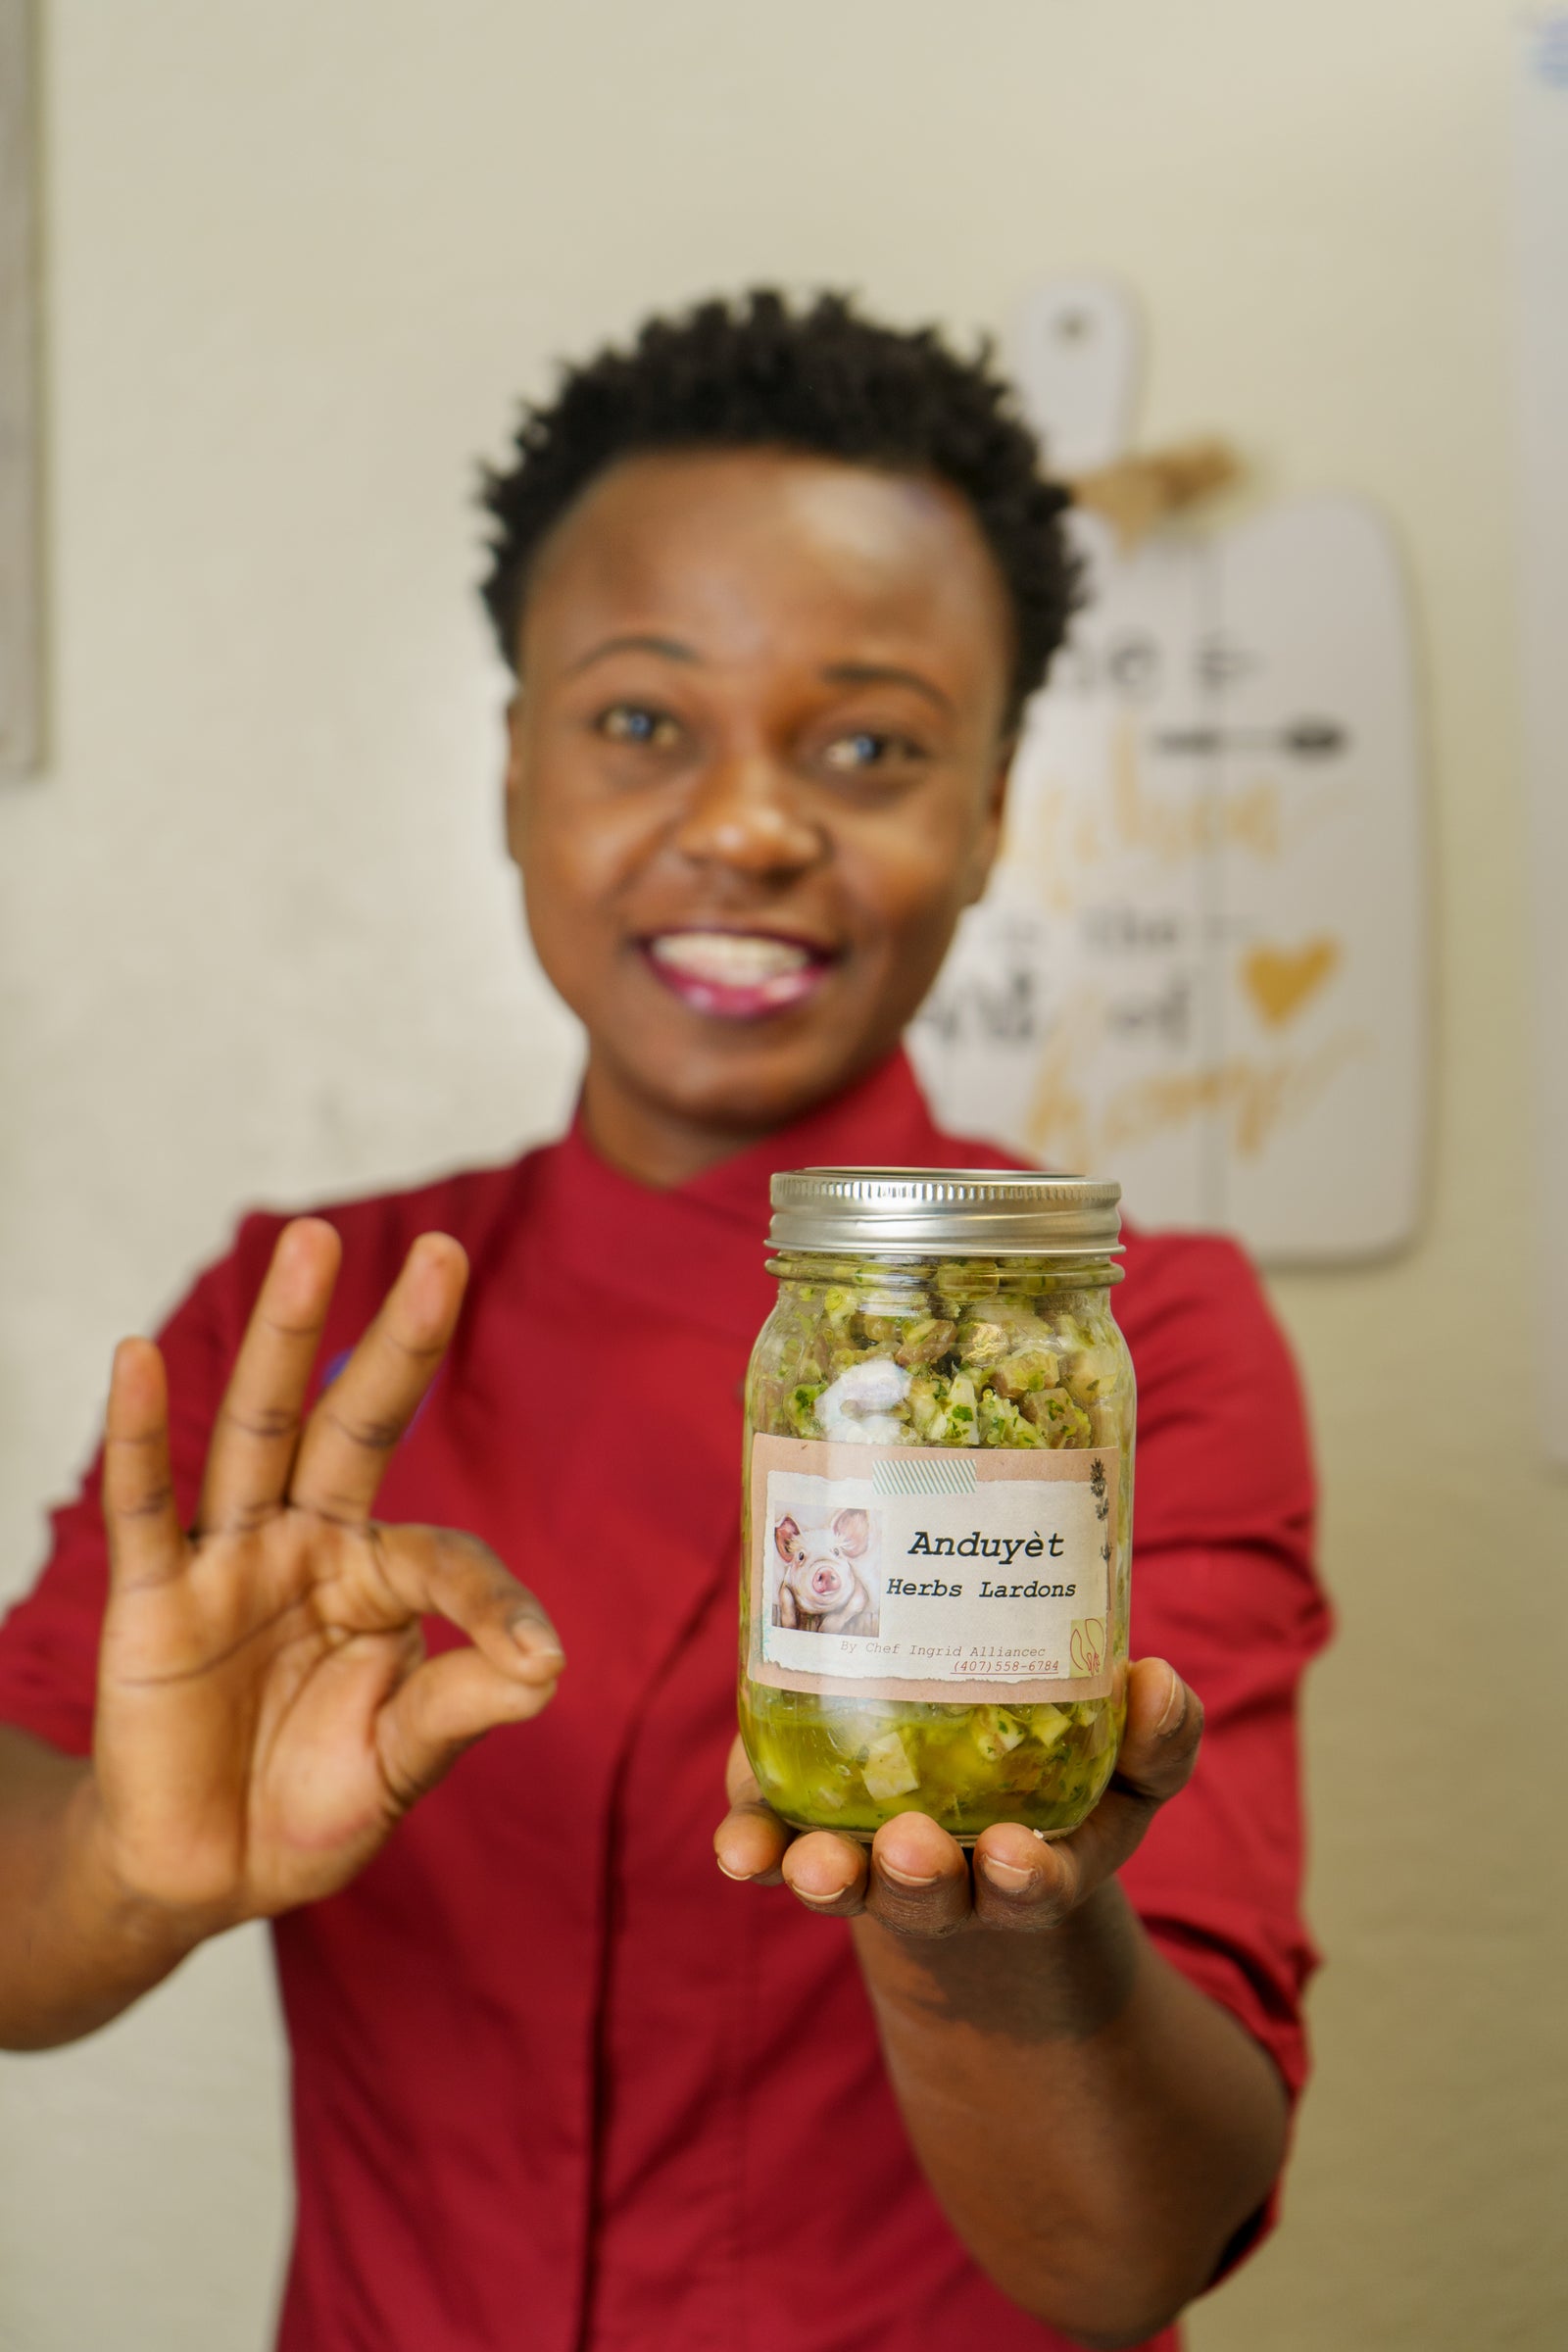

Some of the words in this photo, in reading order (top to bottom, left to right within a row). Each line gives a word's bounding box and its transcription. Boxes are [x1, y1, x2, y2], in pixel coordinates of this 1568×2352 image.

[907, 1531, 1065, 1565] Anduyèt
[885, 1578, 962, 1598] Herbs
[979, 1581, 1077, 1599] Lardons
[840, 1640, 858, 1654] By
[866, 1642, 902, 1656] Chef
[909, 1643, 962, 1658] Ingrid
[954, 1660, 1060, 1674] (407)558-6784
